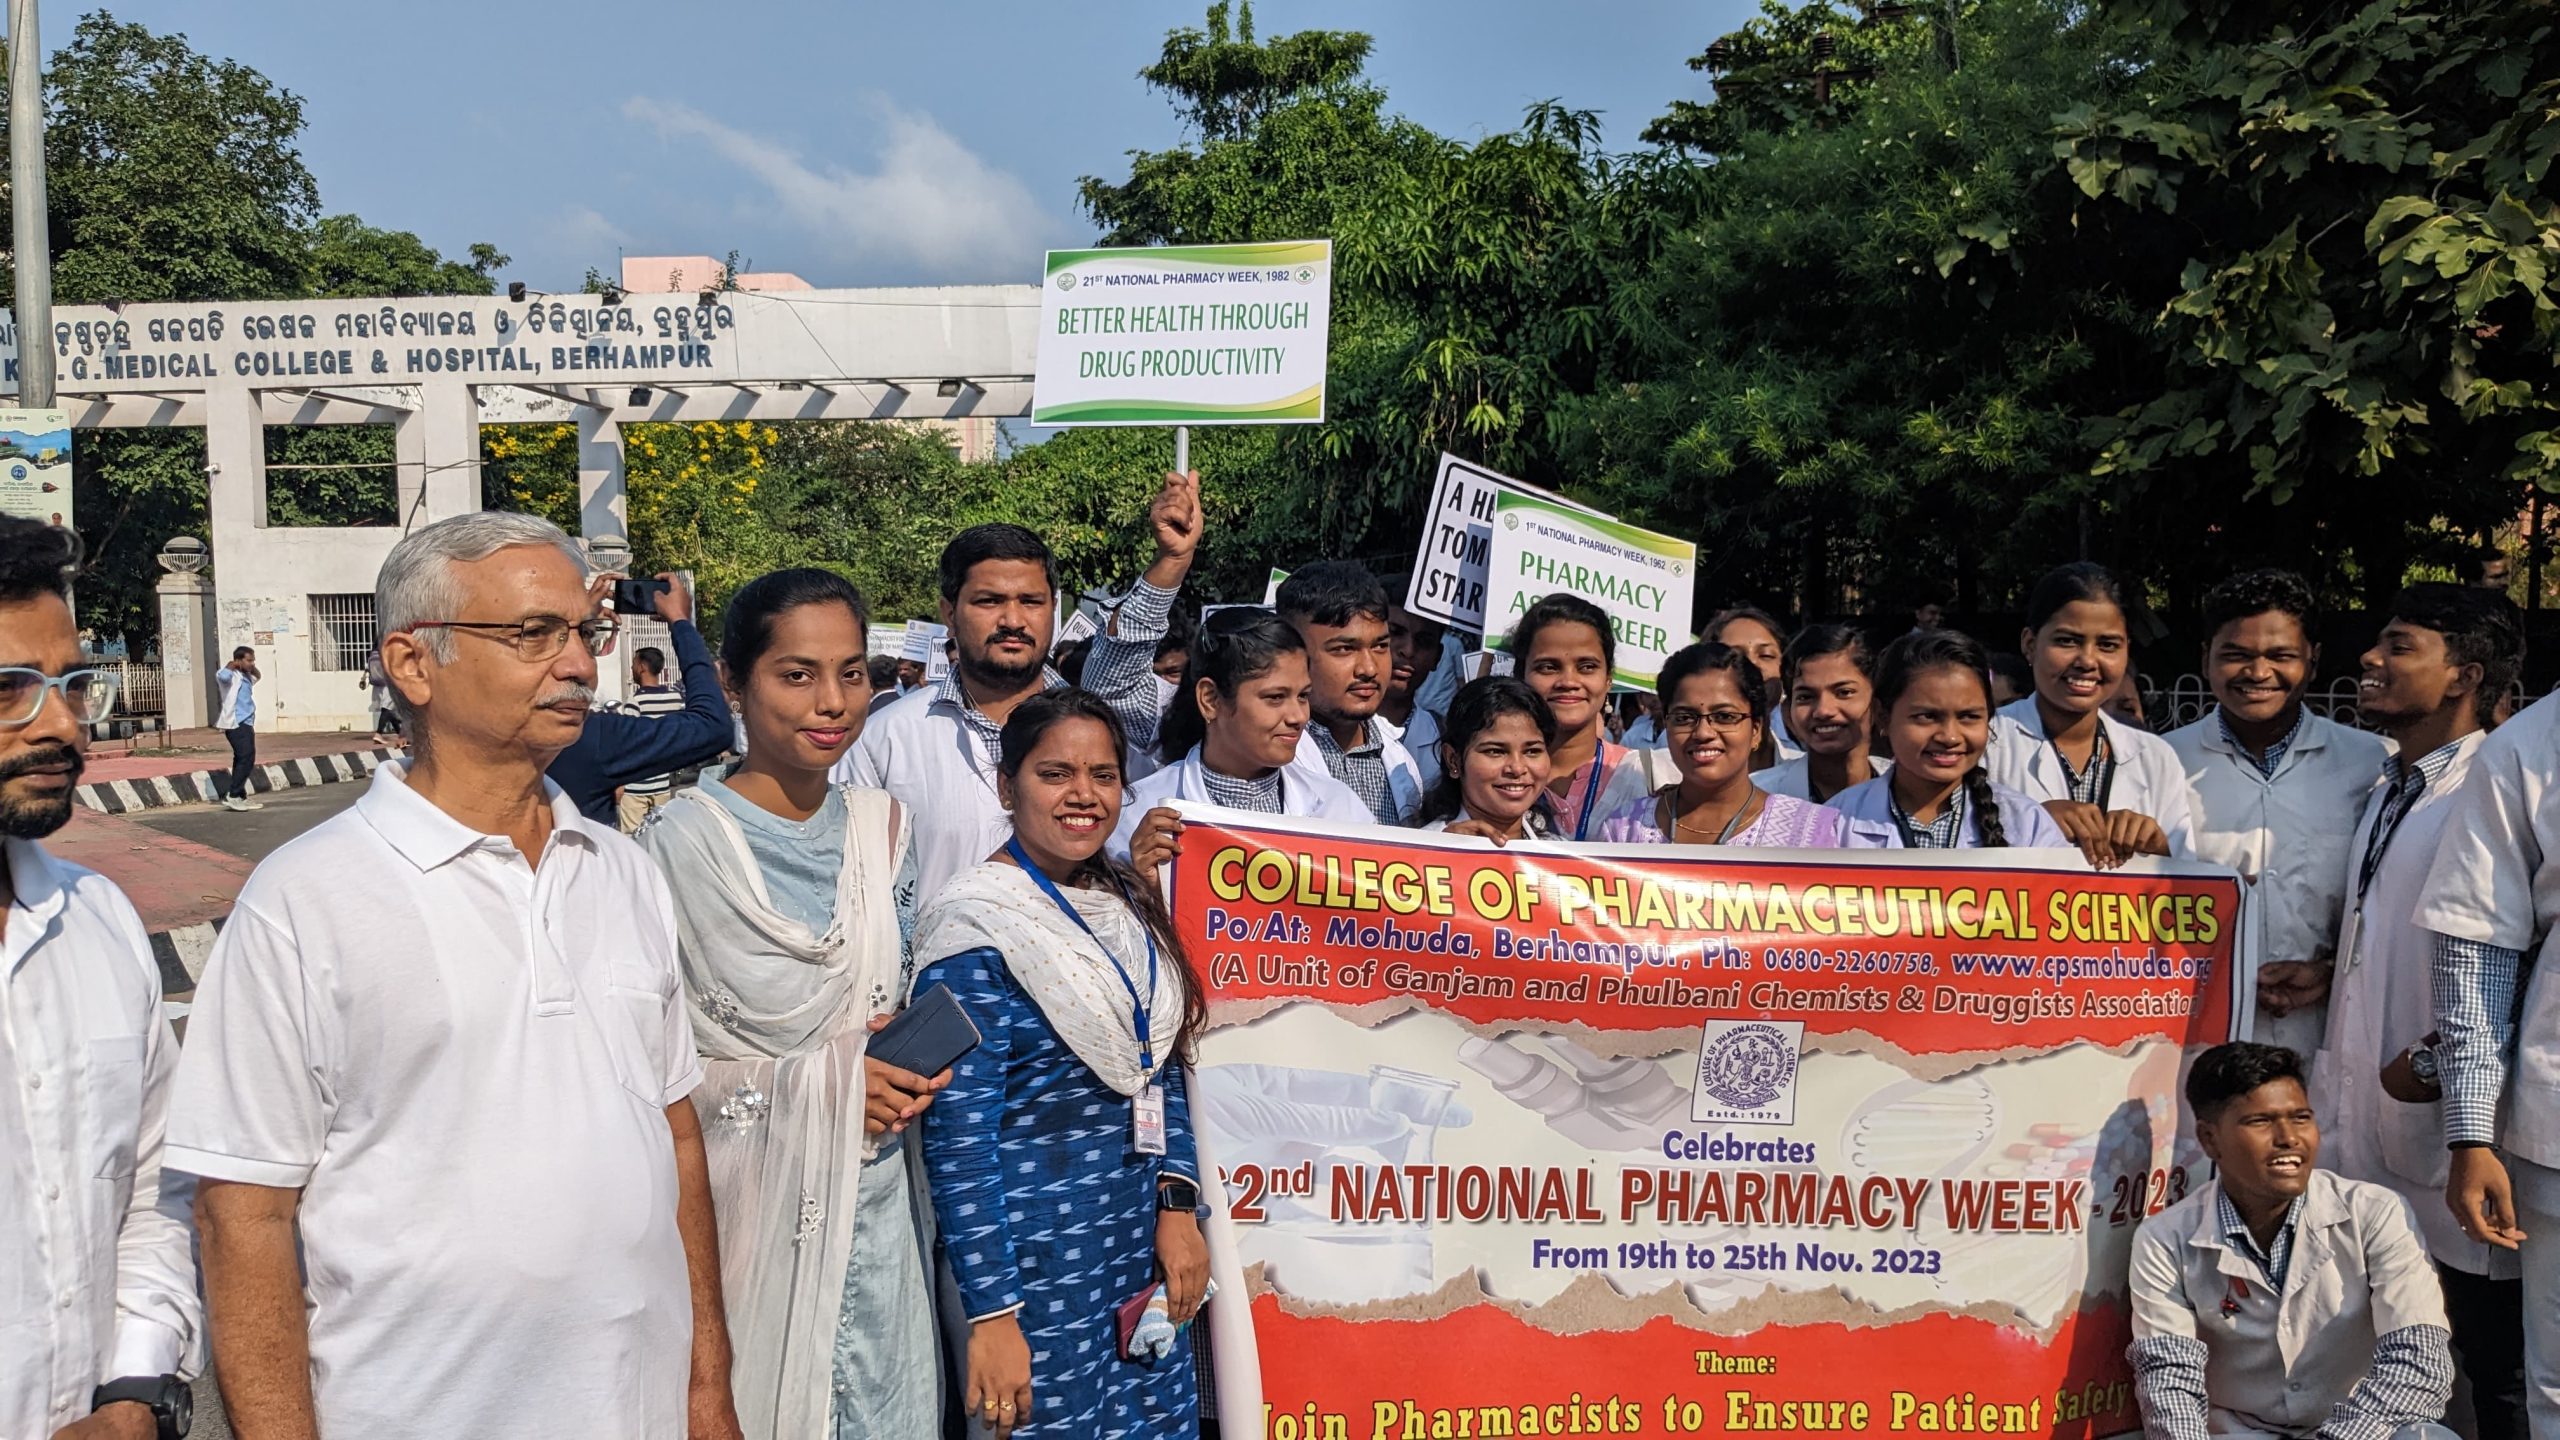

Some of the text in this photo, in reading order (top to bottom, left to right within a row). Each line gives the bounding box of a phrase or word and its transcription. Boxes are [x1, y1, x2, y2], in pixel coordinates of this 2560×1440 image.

[1105, 274, 1160, 286] NATIONAL
[1163, 272, 1226, 284] PHARMACY
[1228, 271, 1263, 284] WEEK,
[1266, 270, 1290, 281] 1982
[148, 310, 224, 342] ଗଜପତି
[494, 308, 510, 334] ଓ
[1057, 302, 1309, 335] BETTER HEALTH THROUGH
[235, 350, 353, 376] COLLEGE
[371, 349, 388, 374] &
[407, 347, 541, 376] HOSPITAL,
[551, 344, 713, 371] BERHAMPUR
[1079, 347, 1286, 378] DRUG PRODUCTIVITY
[1448, 481, 1464, 512] A
[1440, 524, 1490, 567] TOM
[1537, 525, 1578, 545] NATIONAL
[1579, 537, 1622, 557] PHARMACY
[1624, 549, 1648, 566] WEEK,
[1650, 557, 1666, 570] 1962
[1426, 568, 1484, 613] STAR
[1520, 551, 1667, 613] PHARMACY
[1610, 615, 1668, 655] REER
[1208, 846, 2219, 944] COLLEGE OF PHARMACEUTICAL SCIENCES
[1207, 908, 1311, 944] Po/At:
[1325, 916, 1480, 959] Mohuda,
[1493, 927, 1690, 974] Berhampur,
[1702, 936, 1751, 970] Ph:
[1764, 948, 1940, 977] 0680-2260758,
[1210, 953, 1248, 990] (A
[1257, 955, 1329, 987] Unit
[1337, 959, 1377, 988] of
[1384, 964, 1514, 1000] Ganjam
[1524, 974, 1589, 1002] and
[1599, 976, 1741, 1009] Phulbani
[1750, 981, 1889, 1012] Chemists
[1896, 985, 1924, 1012] &
[1933, 986, 2074, 1025] Druggists
[1750, 1111, 1780, 1119] 1979
[1662, 1130, 1815, 1164] Celebrates
[1218, 1160, 1312, 1222] 2nd
[1329, 1162, 1605, 1223] NATIONAL
[1619, 1167, 1929, 1230] PHARMACY
[1942, 1178, 2083, 1233] WEEK
[2111, 1166, 2186, 1225] 2023
[1532, 1239, 1941, 1274] From 19th to 25th Nov. 2023
[1695, 1351, 1776, 1374] Theme:
[1373, 1393, 1641, 1440] Pharmacists
[1664, 1395, 1703, 1432] to
[1724, 1391, 1869, 1432] Ensure
[1890, 1391, 2041, 1433] Patient
[2052, 1381, 2129, 1425] Safety
